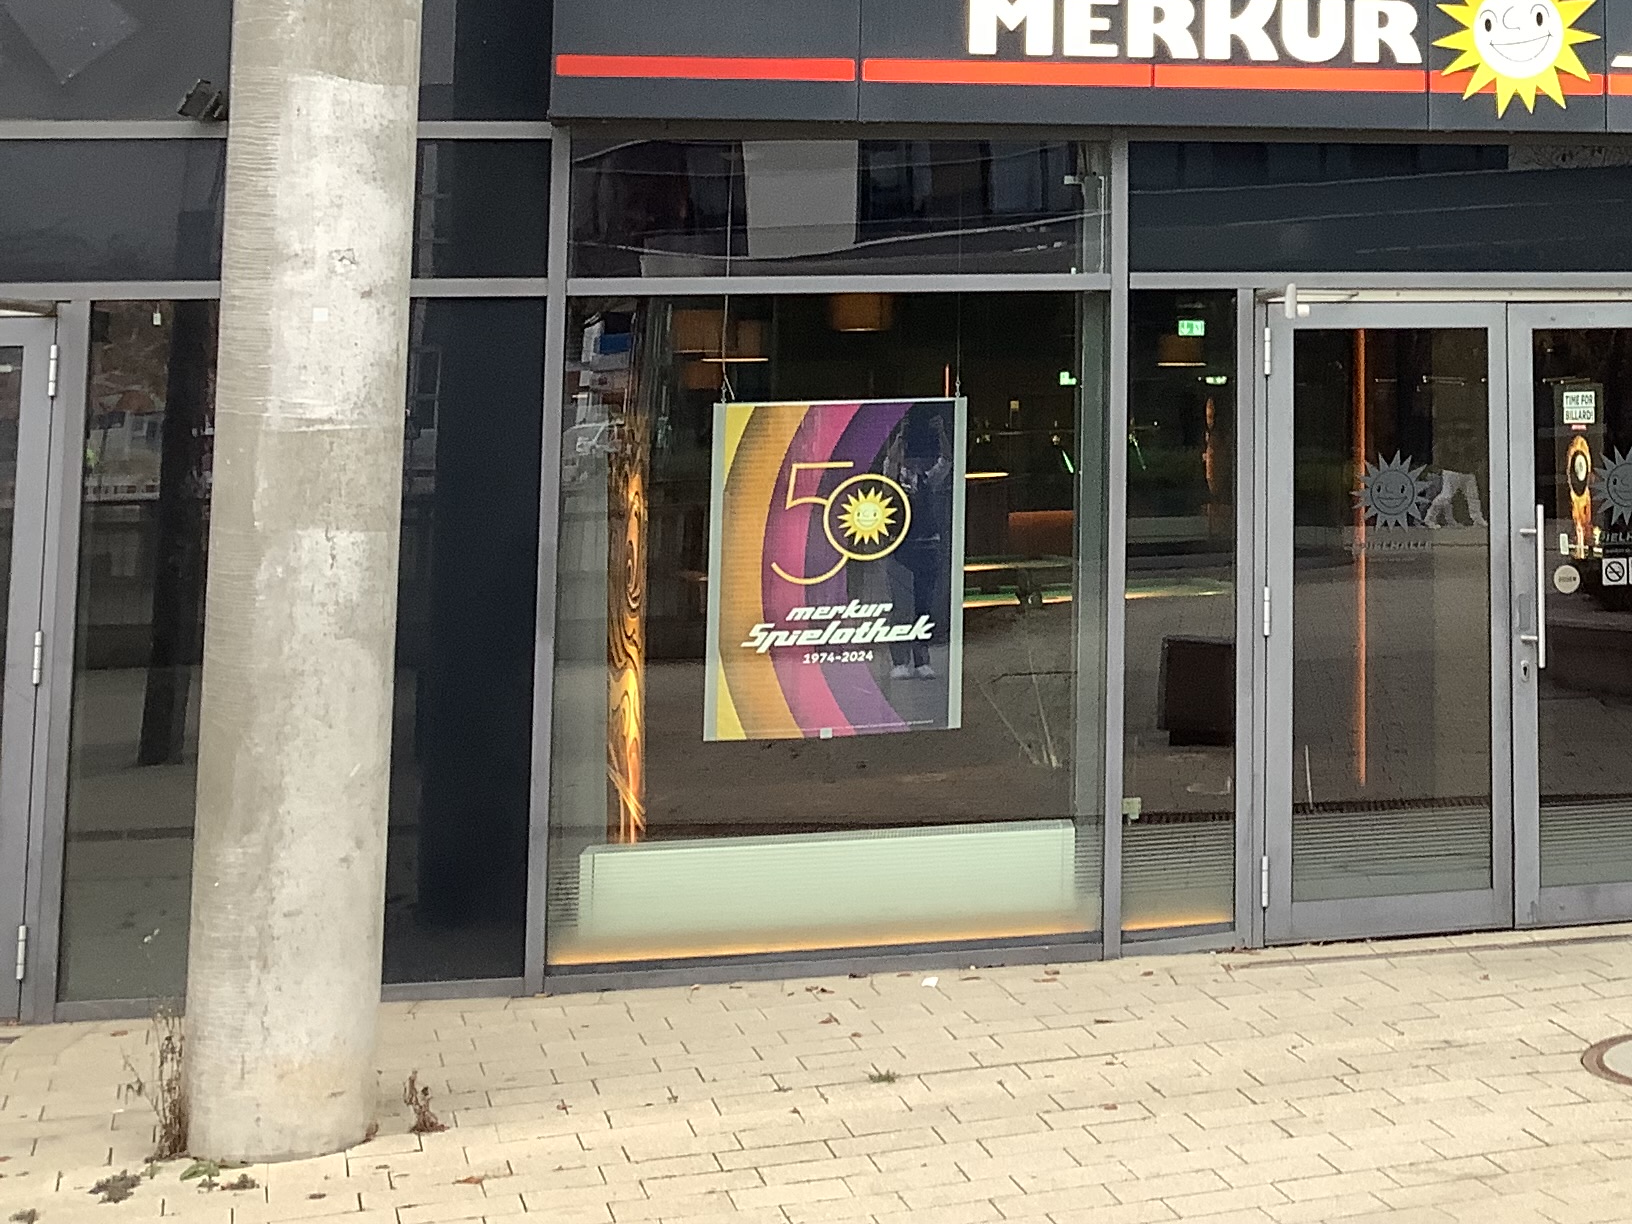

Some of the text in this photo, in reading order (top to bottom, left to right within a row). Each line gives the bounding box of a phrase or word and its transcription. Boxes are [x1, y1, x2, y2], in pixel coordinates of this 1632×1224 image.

[1565, 394, 1580, 405] TIME
[771, 460, 912, 585] 50
[785, 599, 893, 621] merkur
[740, 615, 936, 653] Spielothek
[802, 649, 874, 664] 1974-2024
